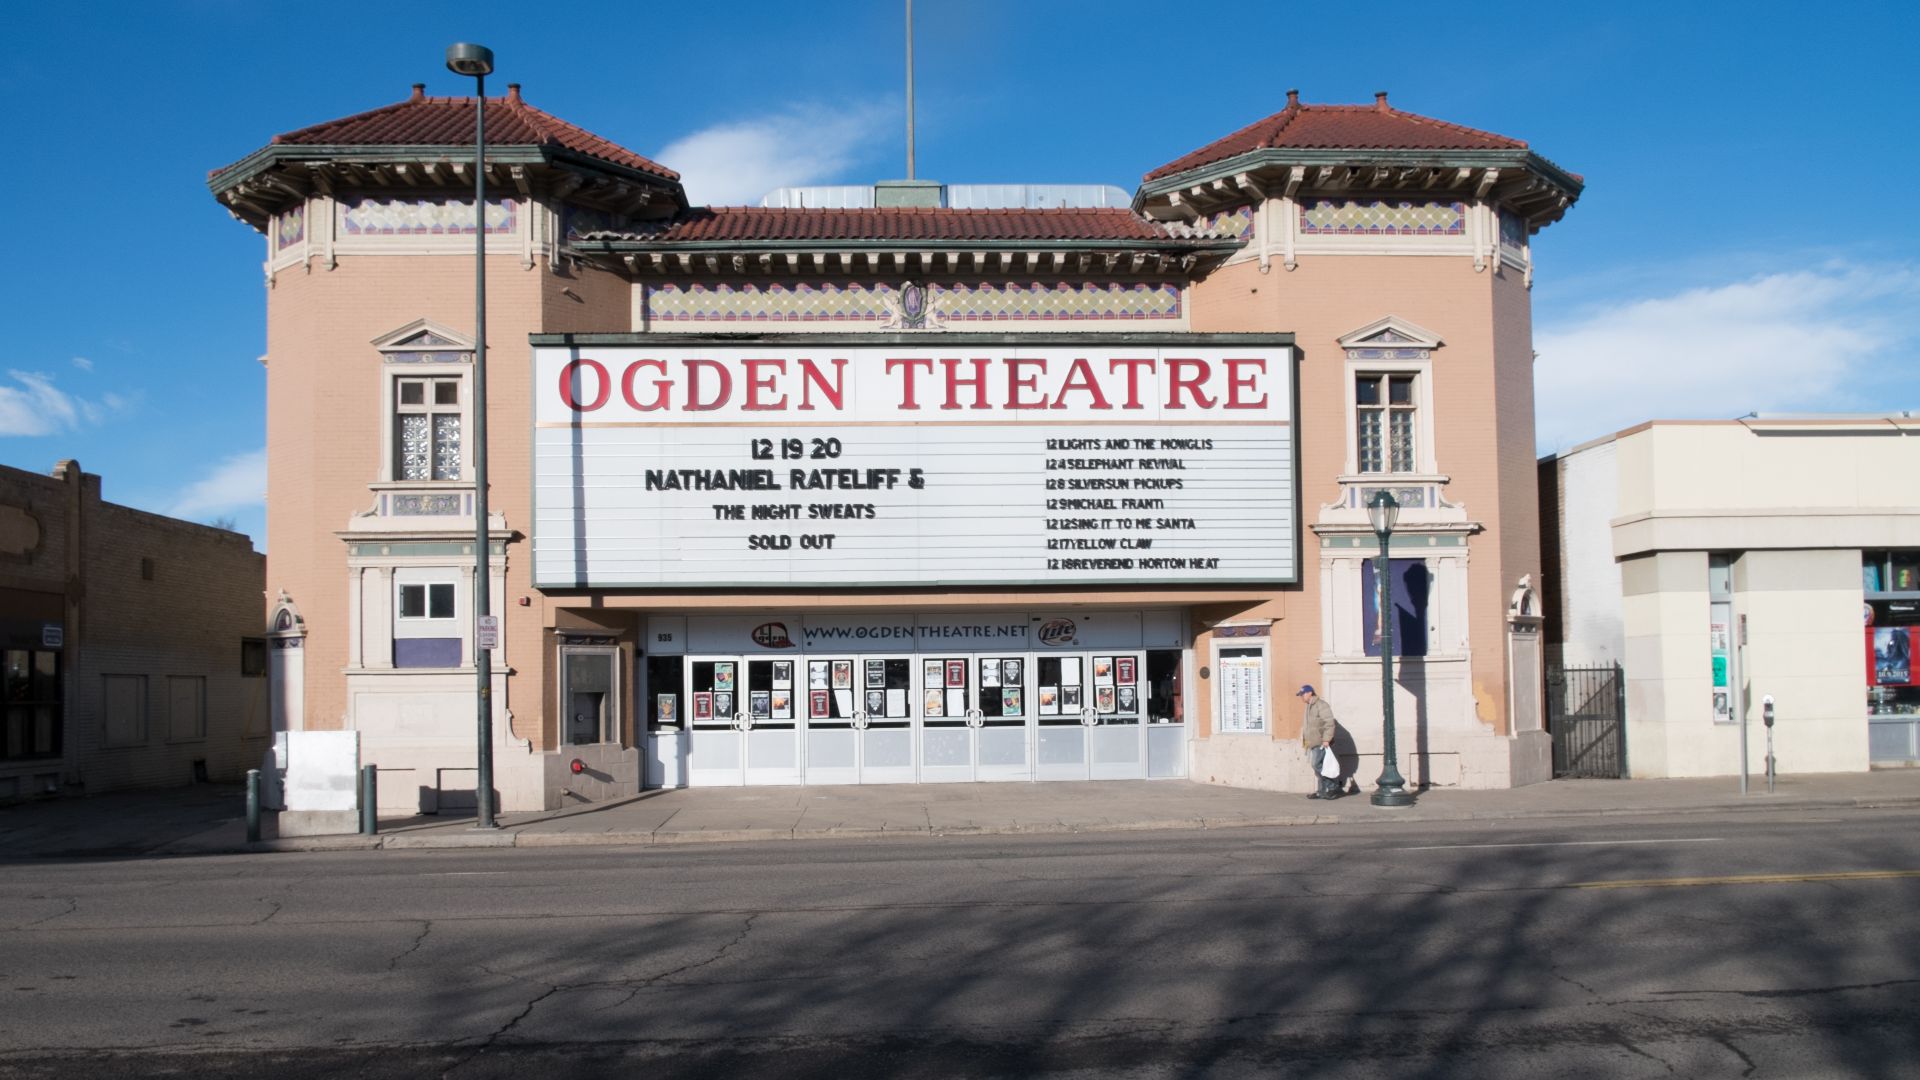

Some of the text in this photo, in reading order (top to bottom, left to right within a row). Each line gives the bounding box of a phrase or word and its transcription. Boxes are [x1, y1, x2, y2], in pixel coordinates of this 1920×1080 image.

[558, 358, 1268, 412] OGDEN THEATRE
[751, 437, 843, 460] 12 19 20
[1105, 438, 1130, 449] AND
[1133, 438, 1156, 449] THE
[1160, 438, 1213, 450] MOWGLIS
[1139, 458, 1186, 470] REVIVAL
[645, 467, 925, 491] NATHANIEL RATELIFF &
[1068, 478, 1129, 490] SILVERSUN
[1133, 478, 1184, 490] PICKUPS
[1121, 499, 1164, 510] FRANTI
[712, 504, 876, 520] THE NIGHT SWEATS
[1101, 518, 1112, 530] IT
[1115, 518, 1132, 530] TO
[1135, 518, 1152, 530] ME
[1156, 518, 1196, 530] SANTA
[748, 534, 835, 550] SOLD OUT
[1119, 538, 1152, 549] CLAW
[1138, 558, 1186, 569] HORTON
[1189, 557, 1220, 569] HEAT
[657, 633, 672, 642] 935
